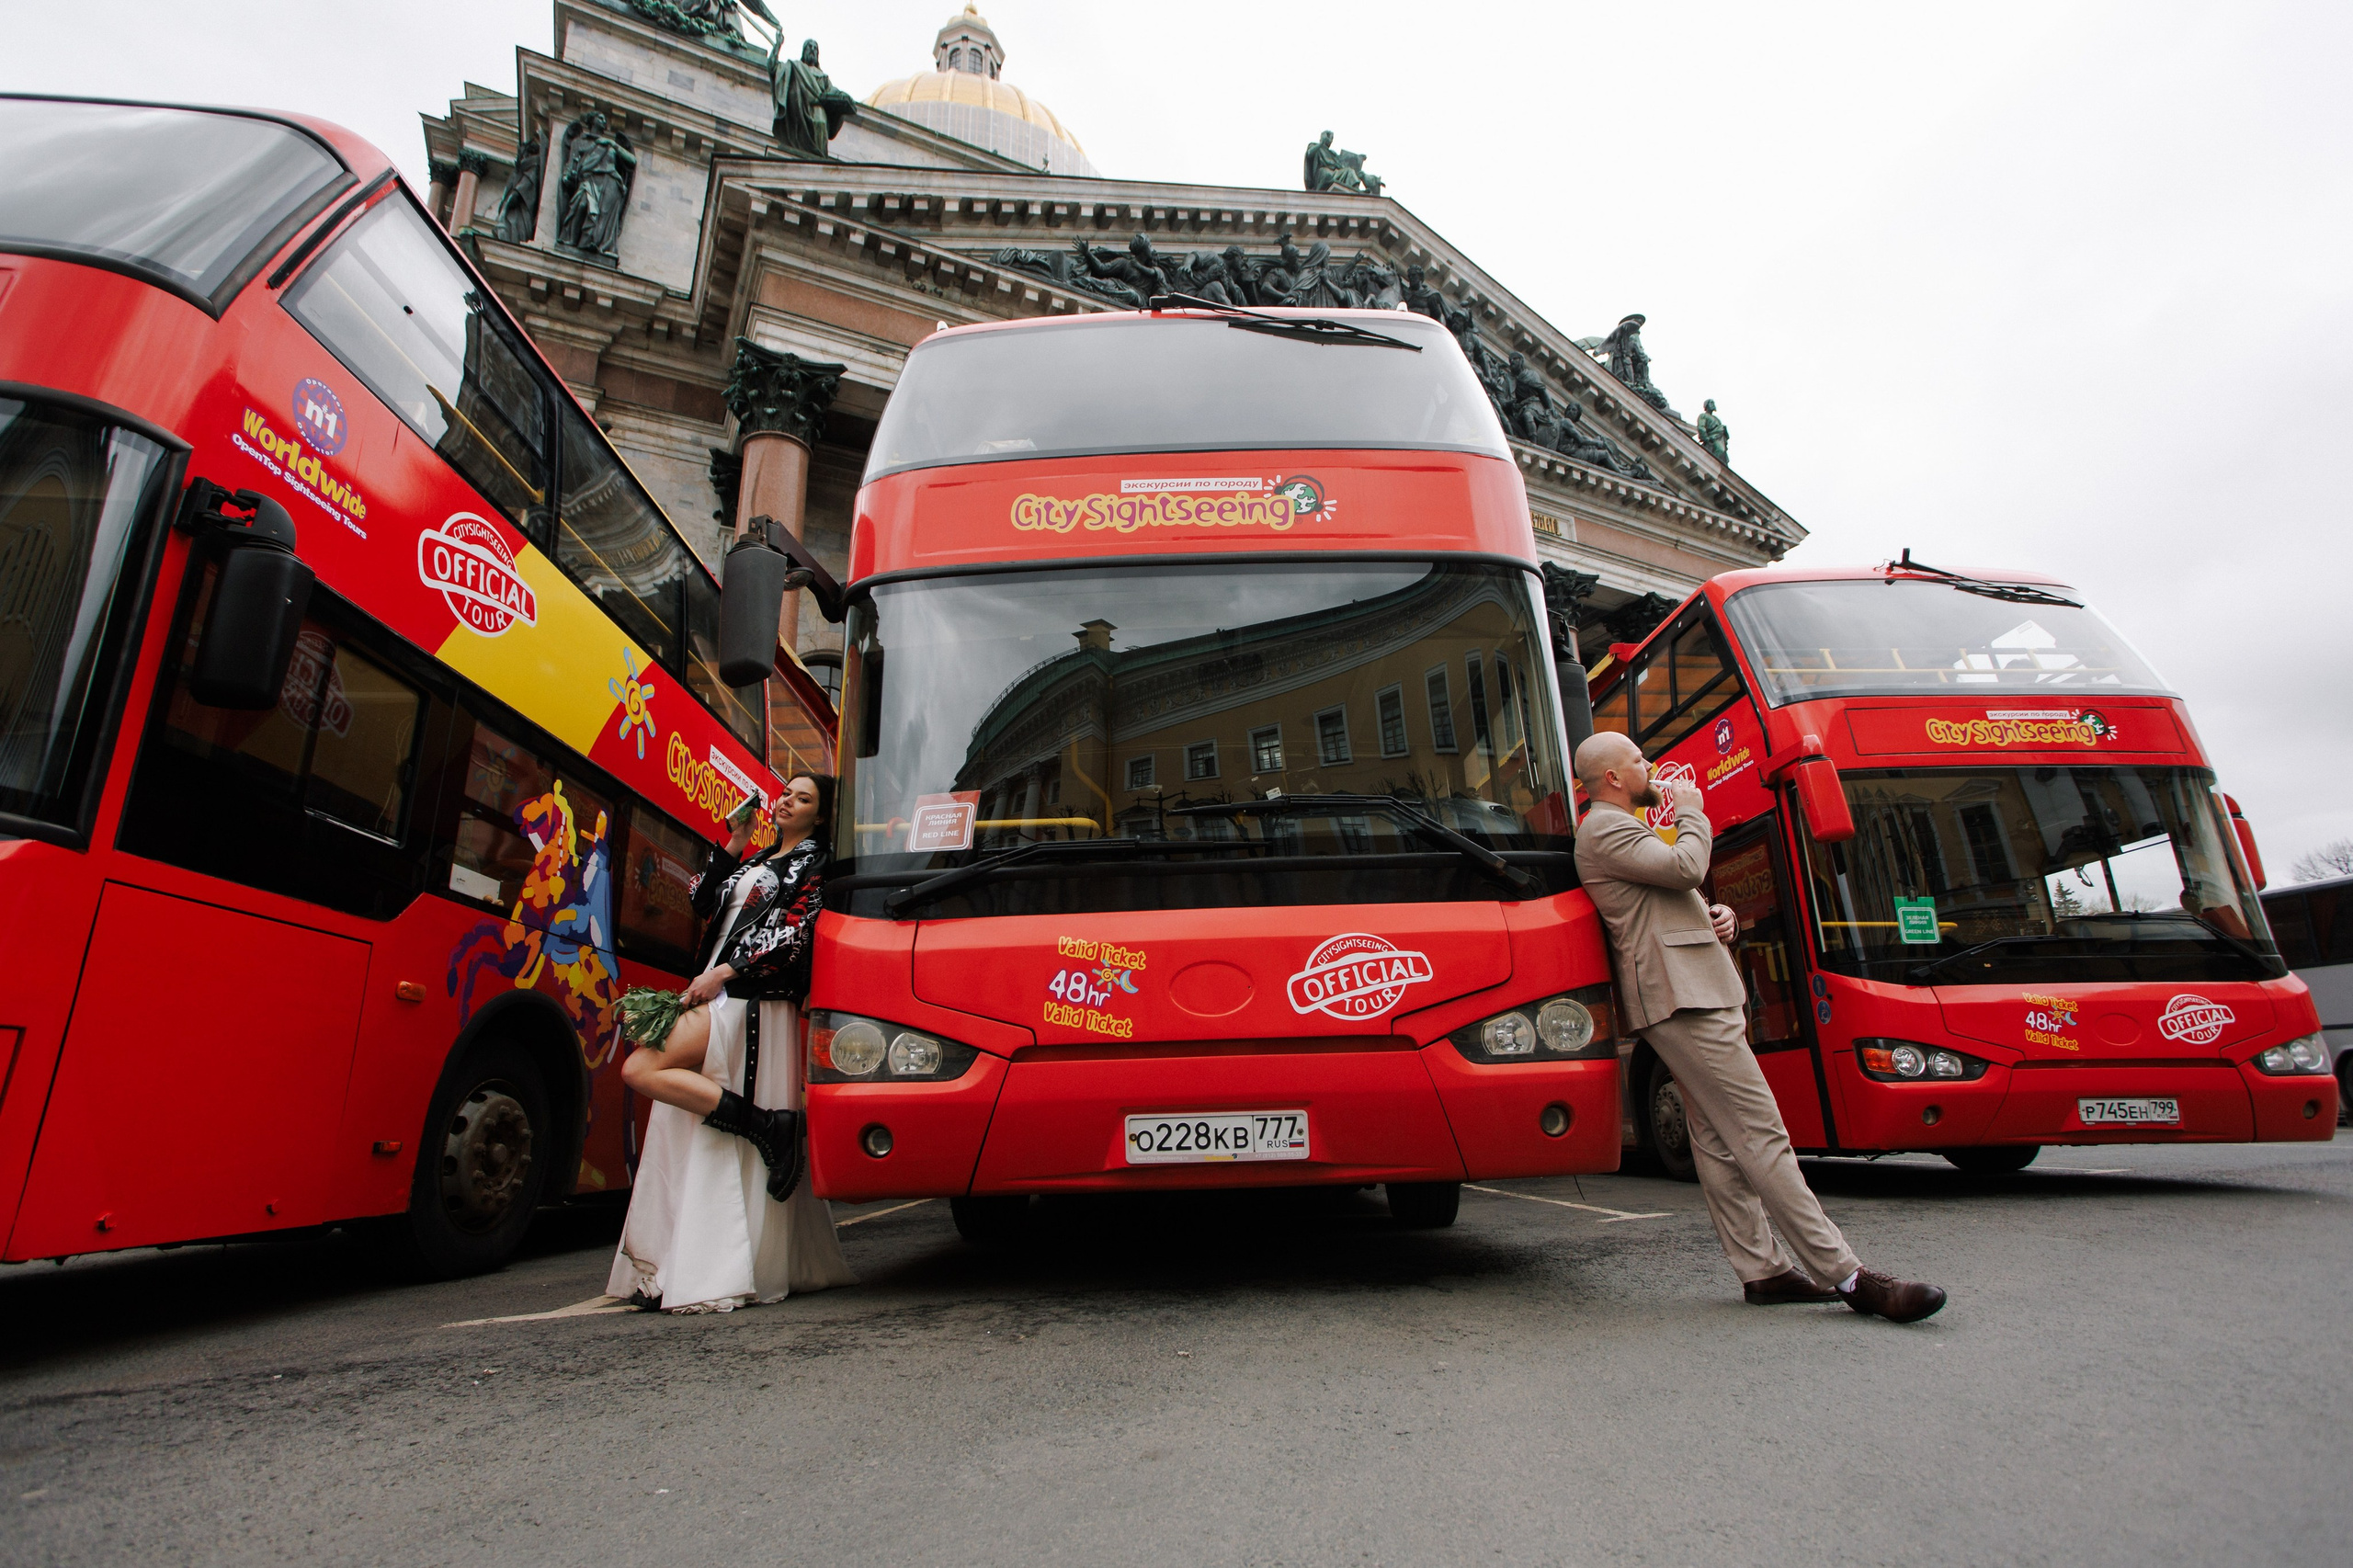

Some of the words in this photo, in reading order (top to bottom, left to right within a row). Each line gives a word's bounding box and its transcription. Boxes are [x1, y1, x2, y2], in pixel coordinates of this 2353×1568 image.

[305, 378, 344, 413] Operador
[297, 421, 334, 456] Operator
[243, 407, 367, 520] Worldwide
[232, 433, 282, 476] OpenTop
[283, 471, 342, 521] Sightseeing
[342, 515, 368, 540] Tours
[1123, 481, 1192, 490] экскурсии
[1214, 480, 1259, 489] городу
[453, 523, 514, 569] CITYSIGHTSEEING
[434, 546, 530, 619] OFFICIAL
[462, 596, 507, 630] TOUR
[711, 751, 742, 782] экскурсии
[742, 778, 749, 789] по
[1707, 746, 1750, 781] Worldwide
[925, 812, 962, 821] КРАСНАЯ
[927, 818, 958, 826] ЛИНИЯ
[940, 829, 960, 837] LINE
[1058, 936, 1098, 960] Valid
[1100, 942, 1146, 971] Ticket
[1317, 938, 1389, 966] CITYSIGHTSEEING
[1048, 970, 1110, 1006] 48hr
[1303, 957, 1423, 1002] OFFICIAL
[1344, 988, 1397, 1013] TOUR
[2022, 992, 2049, 1006] Valid
[2049, 996, 2078, 1012] Ticket
[1044, 1001, 1085, 1028] Valid
[1086, 1009, 1132, 1038] Ticket
[2025, 1011, 2063, 1033] 48hr
[2166, 1008, 2230, 1033] OFFICIAL
[2190, 1026, 2219, 1040] TOUR
[2025, 1028, 2050, 1045] Valid
[2051, 1034, 2079, 1051] Ticket
[2151, 1101, 2174, 1114] 799
[1255, 1117, 1298, 1140] 777
[1267, 1140, 1289, 1149] RUS
